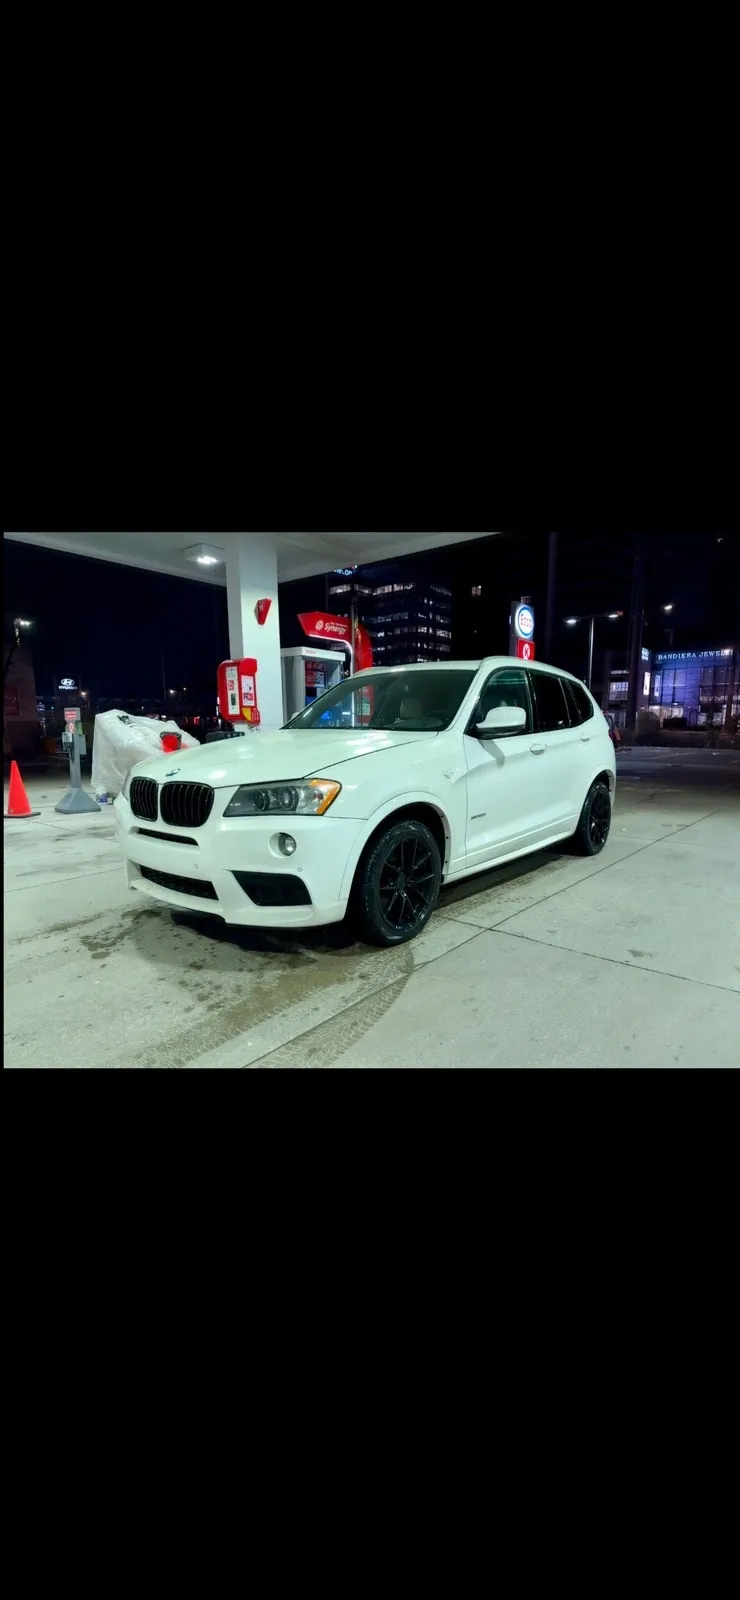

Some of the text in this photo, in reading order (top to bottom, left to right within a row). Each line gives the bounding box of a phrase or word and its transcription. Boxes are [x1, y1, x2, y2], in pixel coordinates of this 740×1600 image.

[520, 613, 533, 628] Esso
[324, 622, 347, 635] Synergy
[658, 651, 697, 661] BANDIERA
